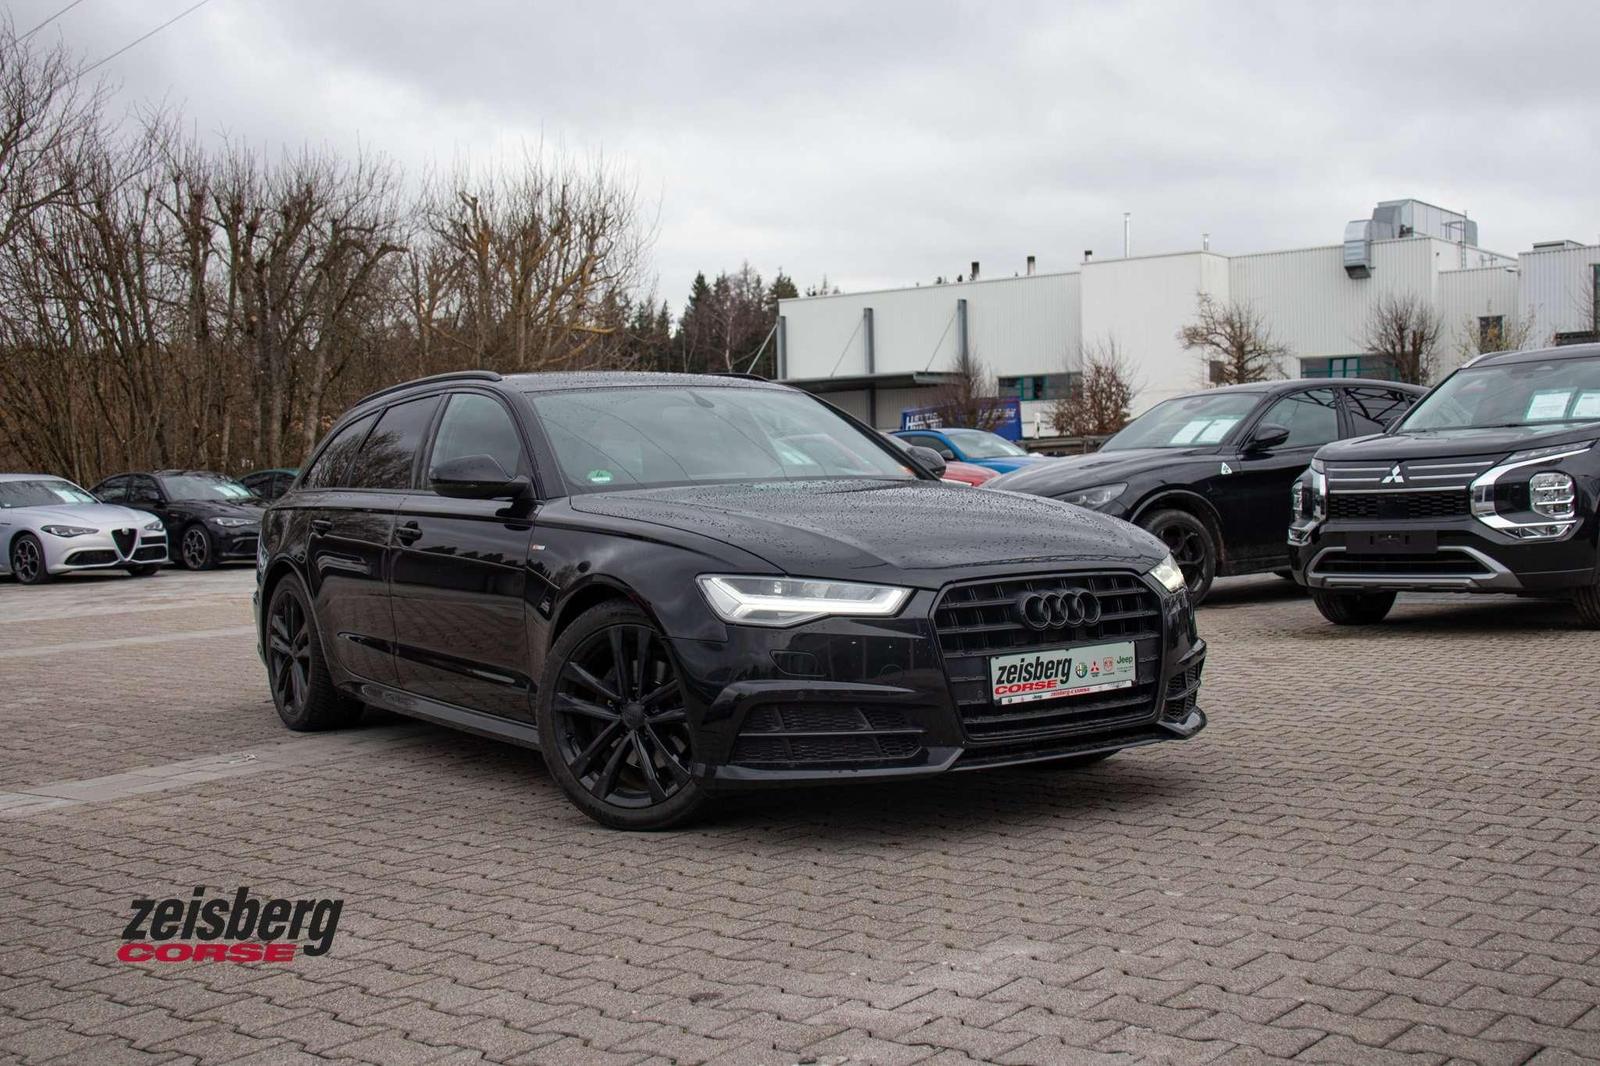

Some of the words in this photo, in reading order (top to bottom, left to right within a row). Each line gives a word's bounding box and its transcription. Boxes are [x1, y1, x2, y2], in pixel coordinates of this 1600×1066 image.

[1116, 655, 1134, 665] Jeep
[996, 656, 1072, 685] zeisberg
[994, 679, 1058, 696] CORSE
